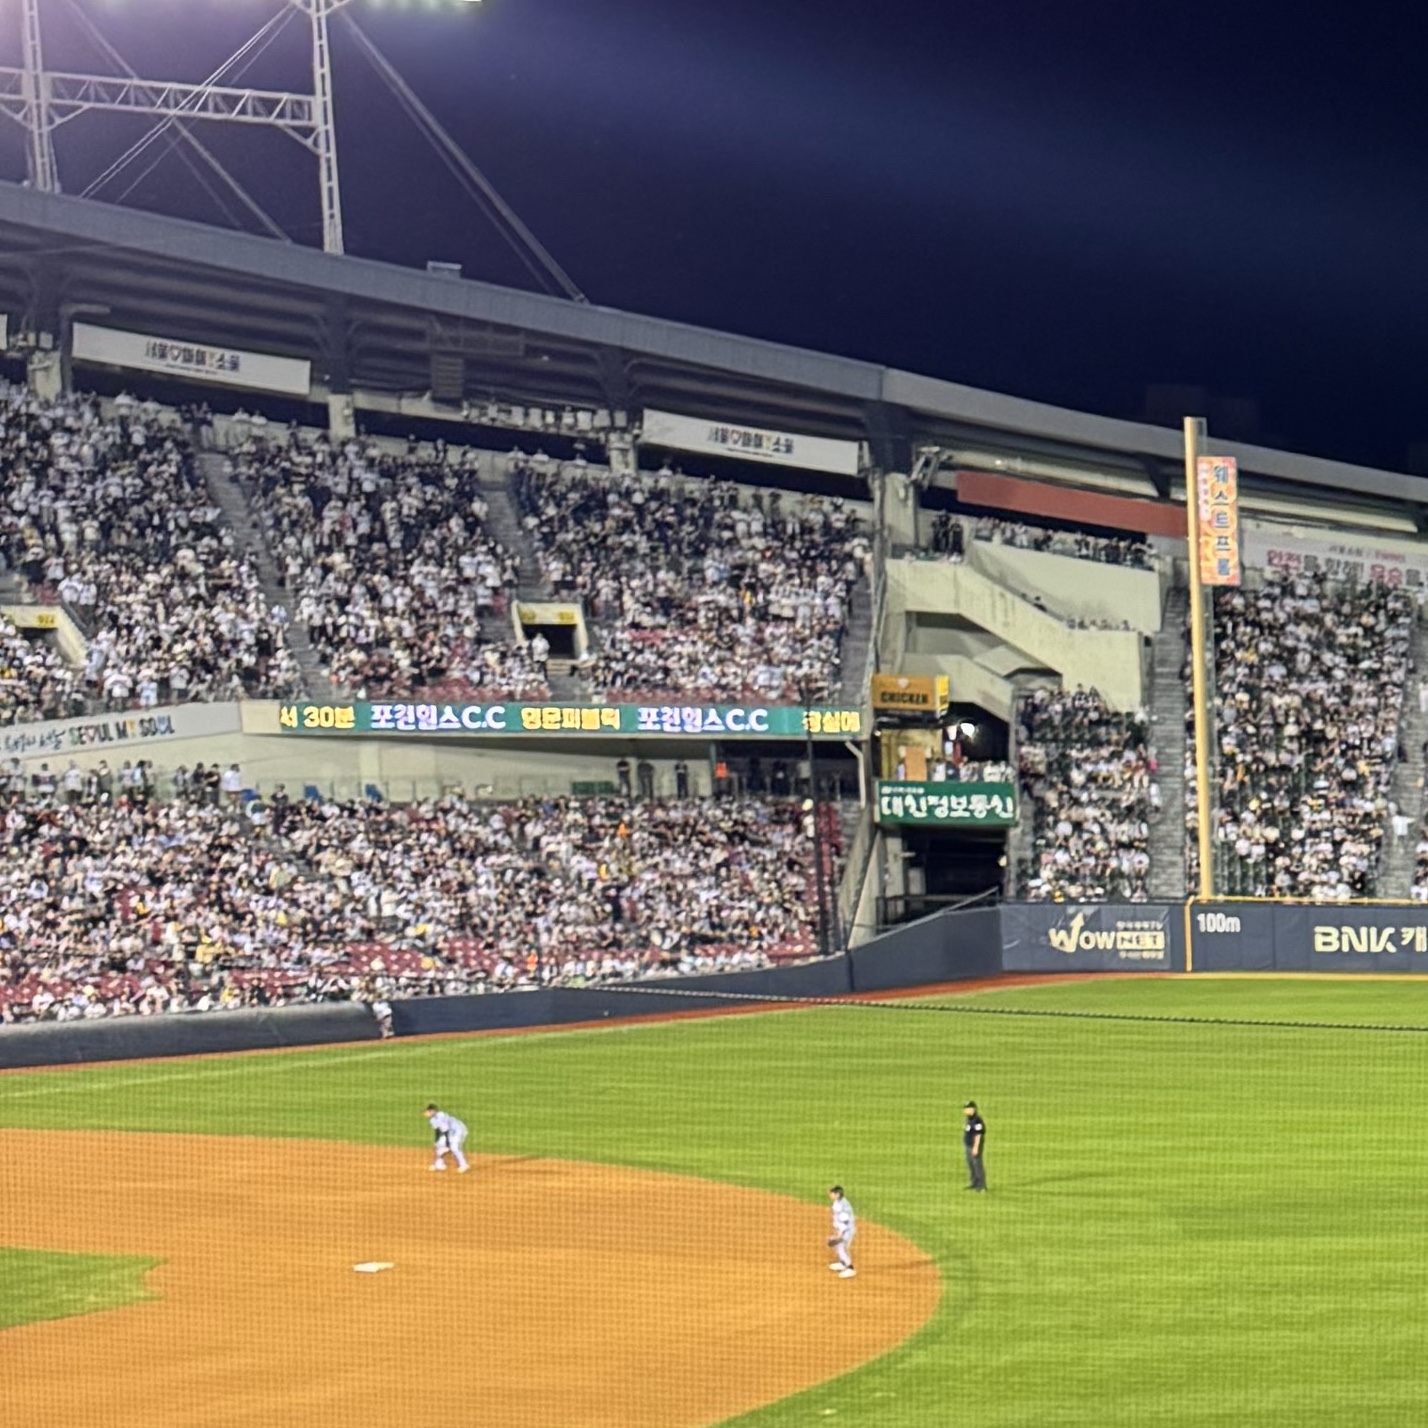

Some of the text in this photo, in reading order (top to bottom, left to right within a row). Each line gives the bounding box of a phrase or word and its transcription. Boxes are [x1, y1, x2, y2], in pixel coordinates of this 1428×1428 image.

[68, 724, 114, 746] SEOUL
[139, 714, 176, 738] SOUL
[881, 794, 1014, 818] 대신정보통신
[1197, 913, 1241, 933] 100m
